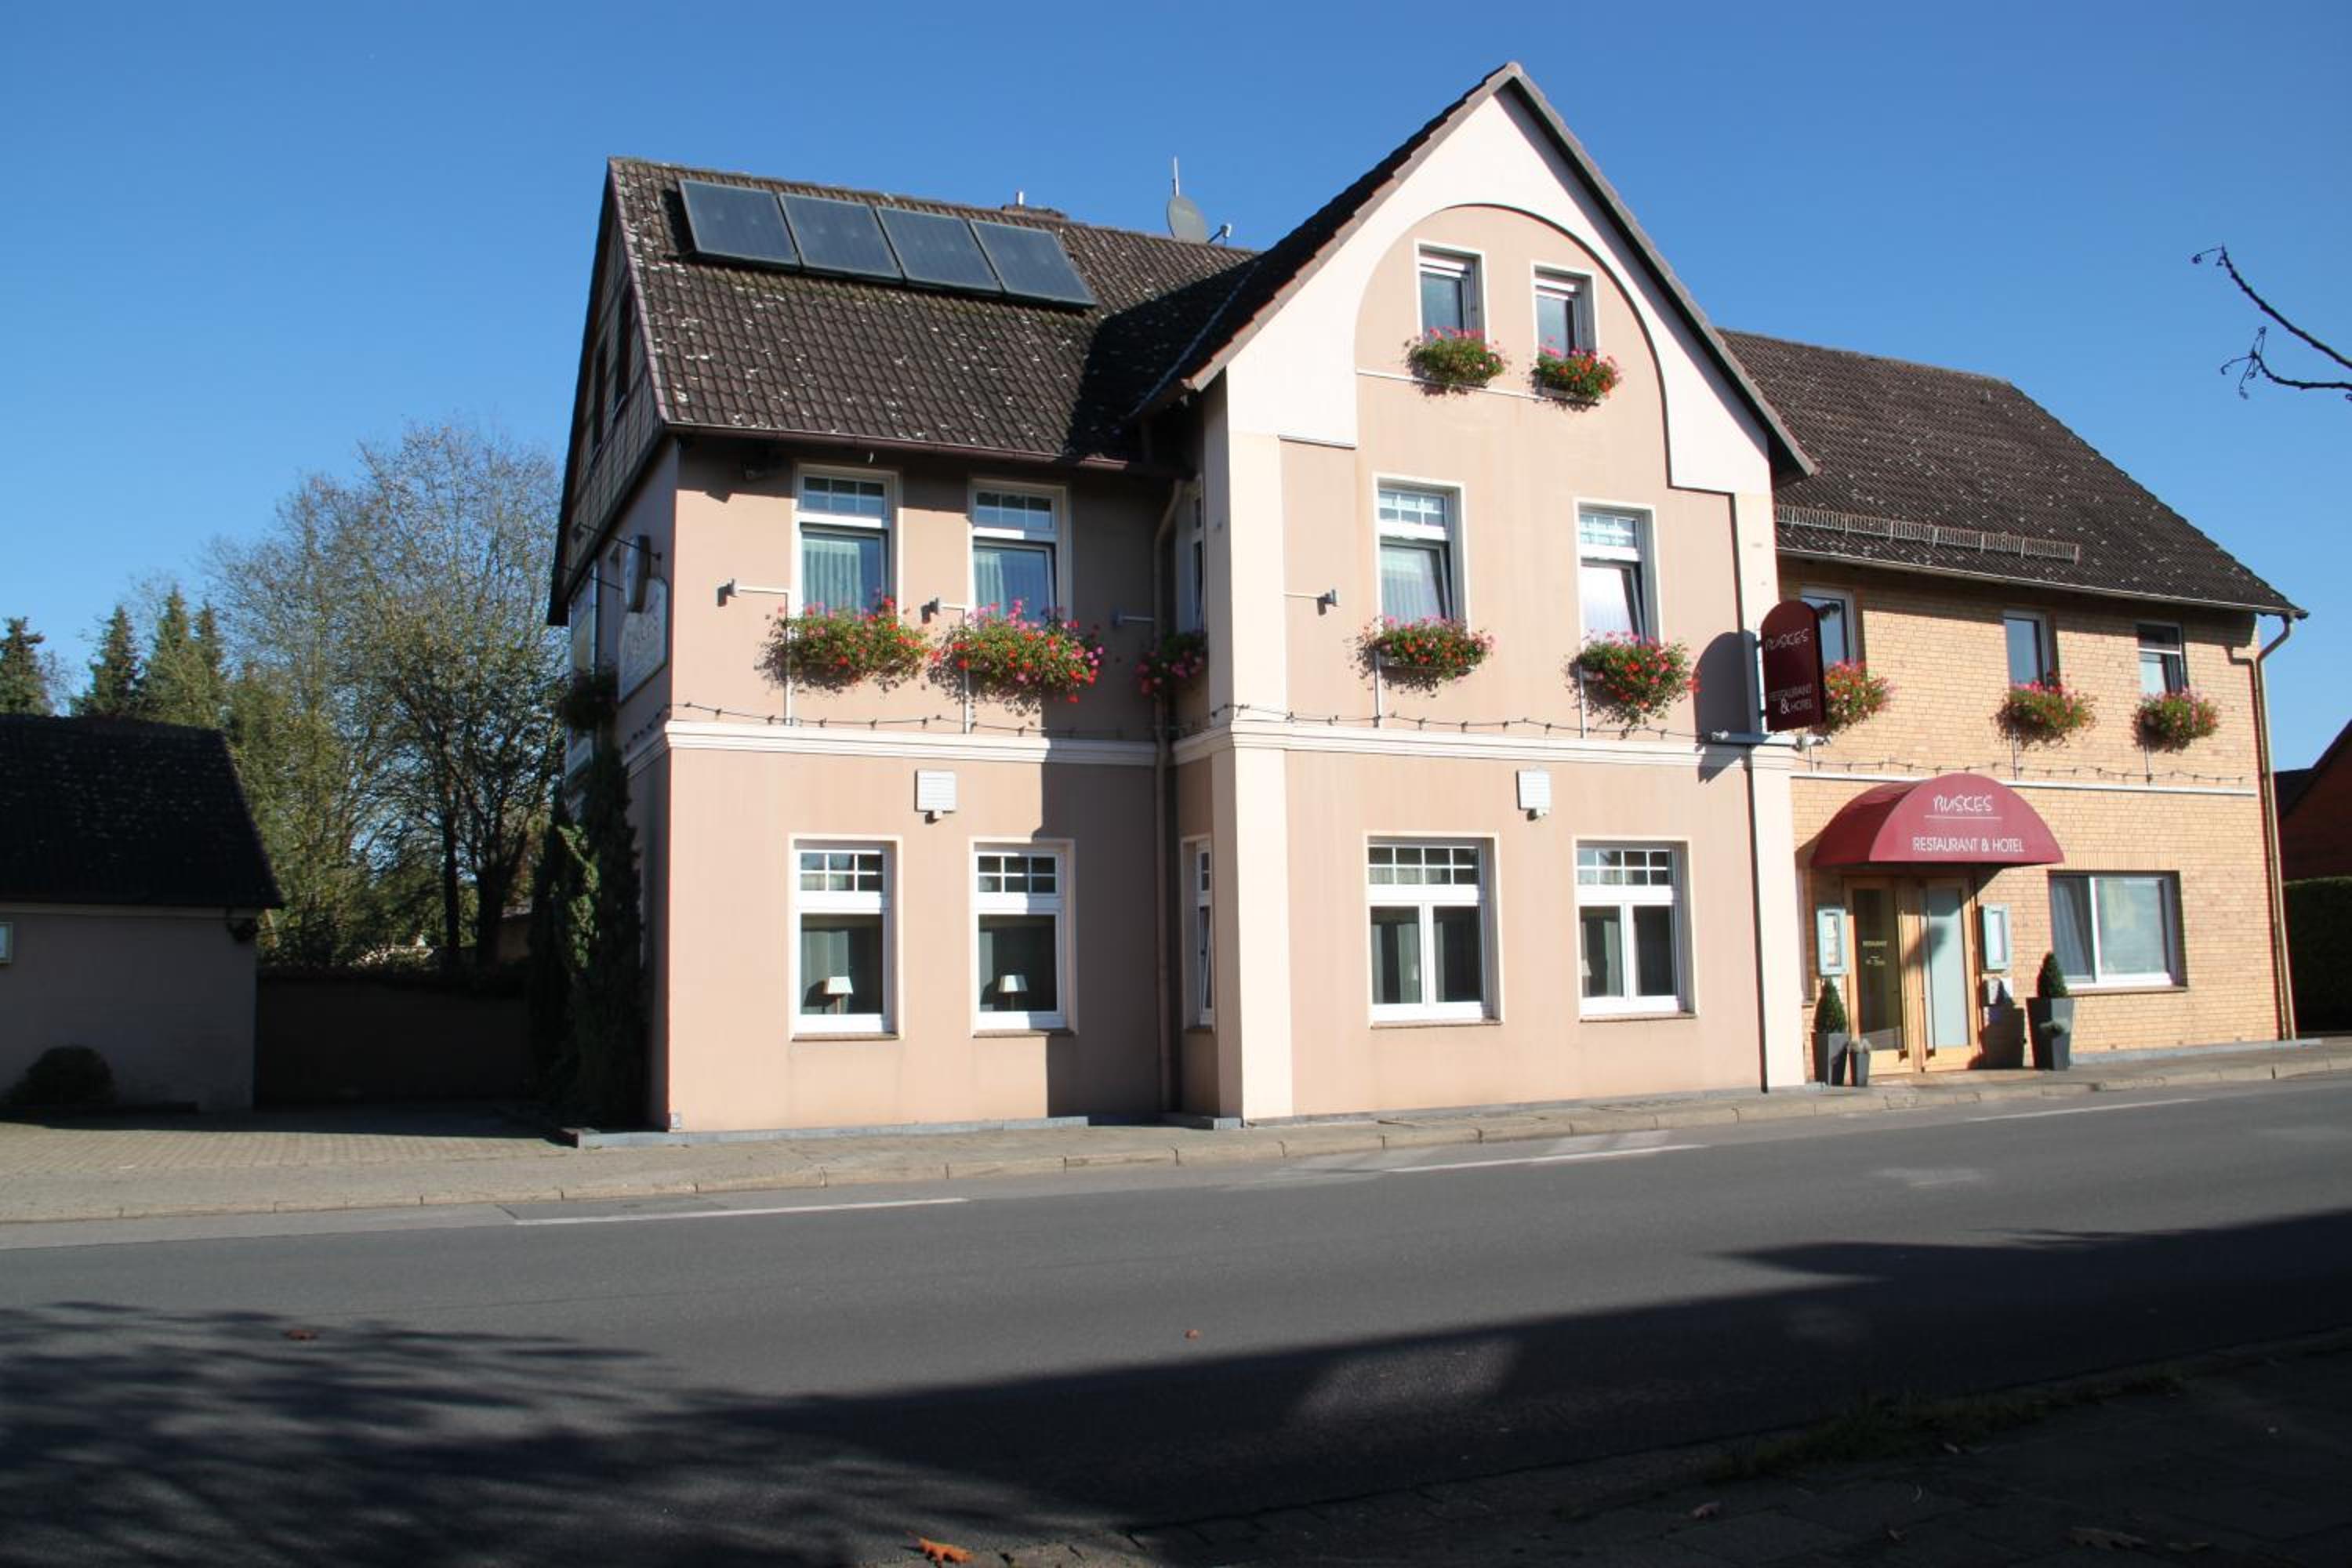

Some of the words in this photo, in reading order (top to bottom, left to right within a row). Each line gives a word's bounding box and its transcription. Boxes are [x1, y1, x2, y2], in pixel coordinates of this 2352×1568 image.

[1780, 697, 1791, 715] &
[1911, 836, 1979, 852] RESTAURANT
[1981, 837, 1990, 853] &
[1991, 837, 2025, 853] HOTEL
